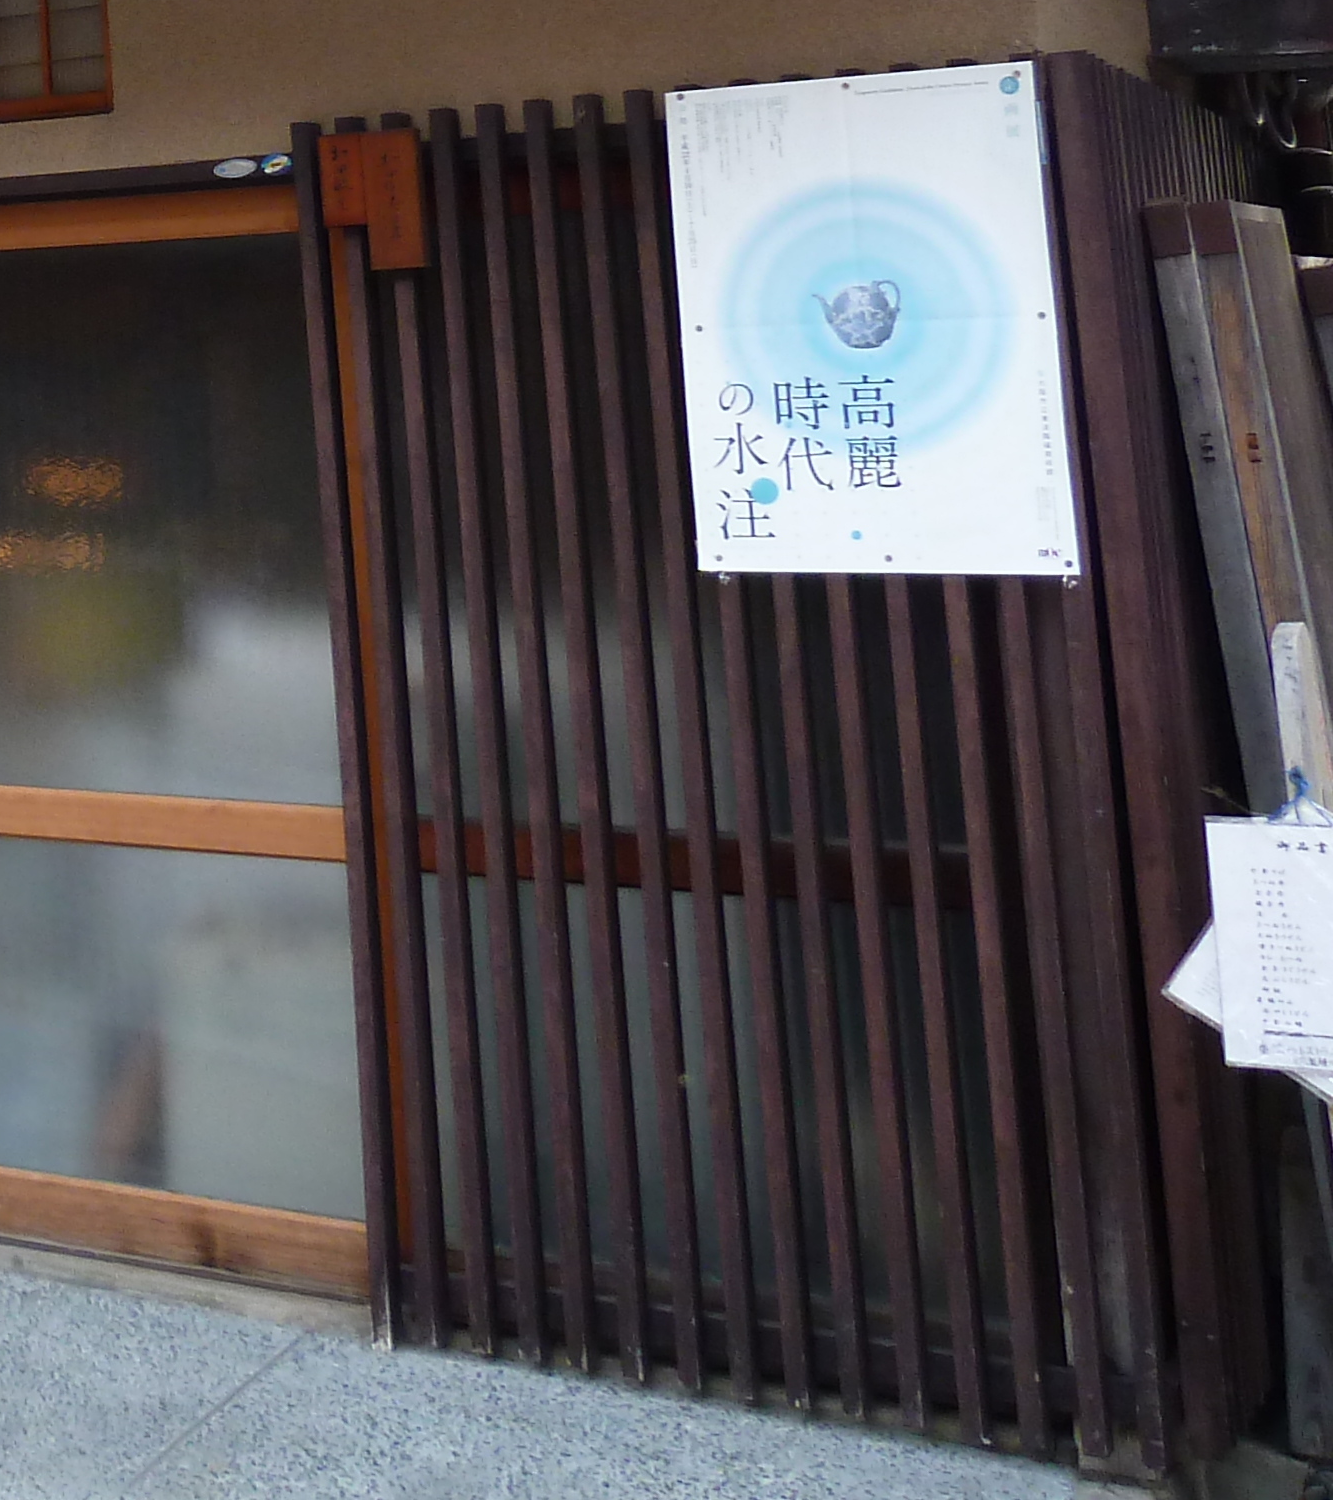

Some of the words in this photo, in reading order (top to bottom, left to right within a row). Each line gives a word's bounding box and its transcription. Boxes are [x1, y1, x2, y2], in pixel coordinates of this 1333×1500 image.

[712, 382, 777, 541] の水注
[772, 376, 835, 491] 時代
[837, 374, 902, 489] 高麗
